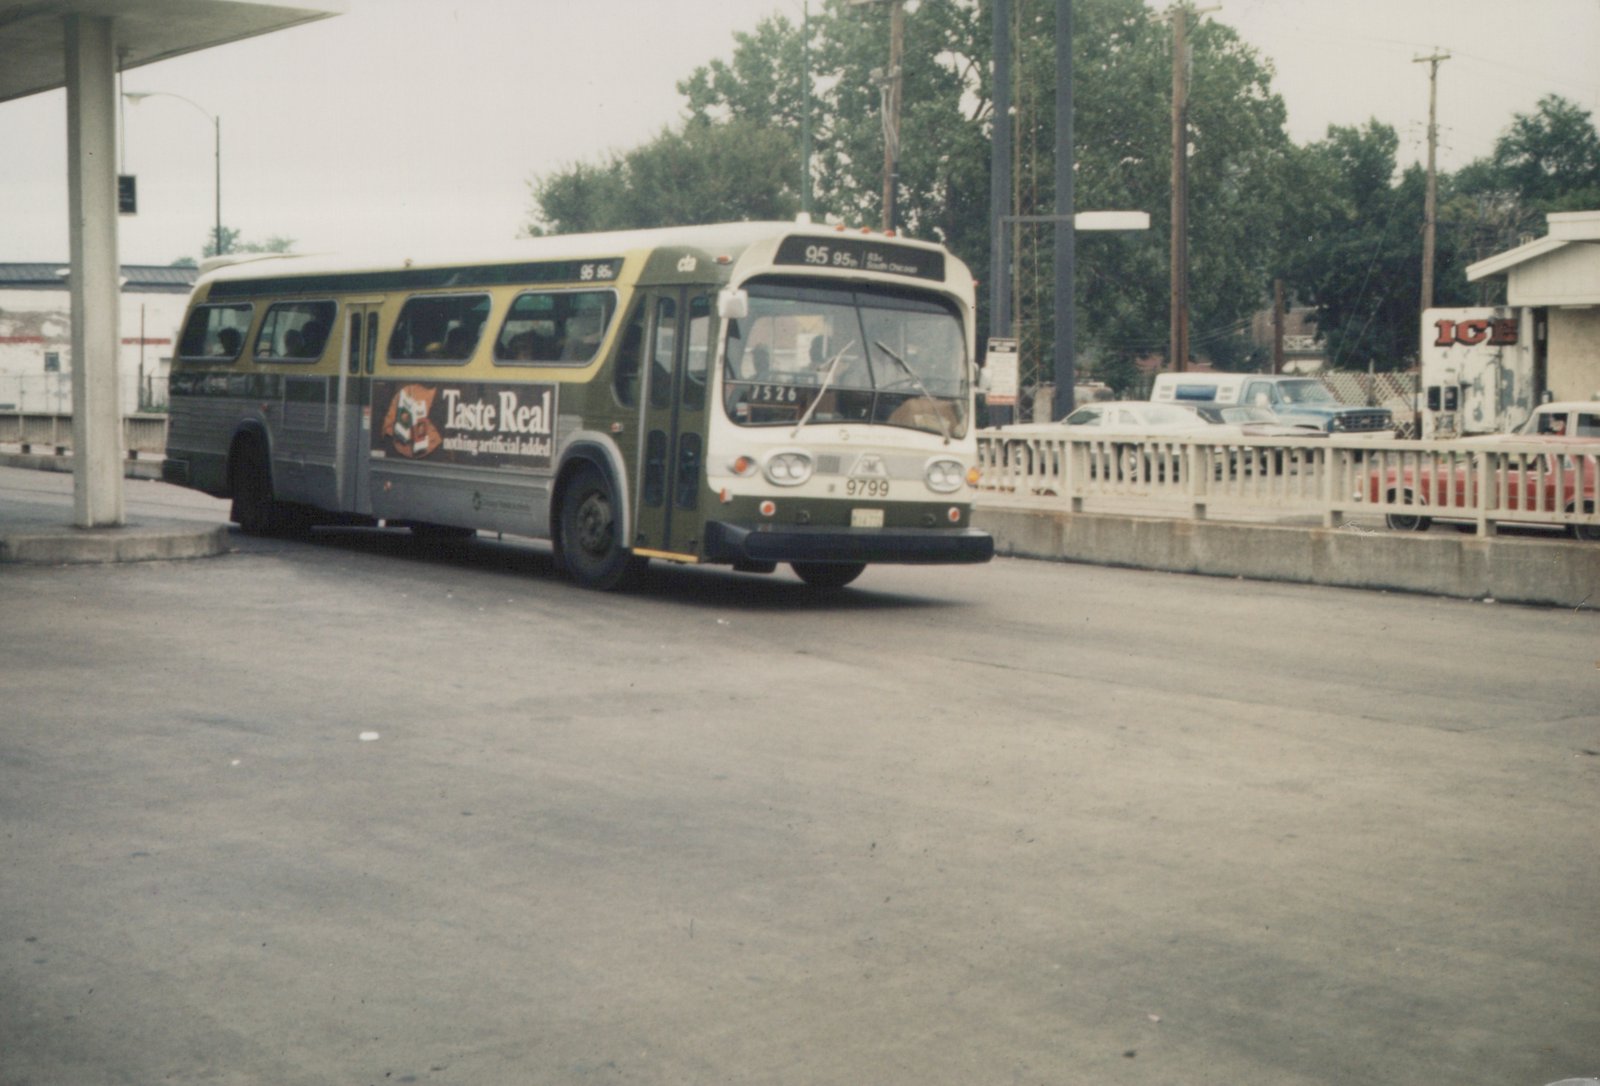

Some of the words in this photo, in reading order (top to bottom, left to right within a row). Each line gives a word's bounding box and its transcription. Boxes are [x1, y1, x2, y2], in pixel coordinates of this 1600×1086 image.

[805, 245, 829, 265] 95
[1434, 319, 1518, 347] ICE
[752, 384, 797, 402] 7526
[442, 389, 496, 431] Taste
[499, 391, 551, 434] Real
[443, 433, 478, 456] nothing
[478, 435, 520, 455] artificial
[520, 437, 551, 457] added
[846, 479, 889, 497] 9799
